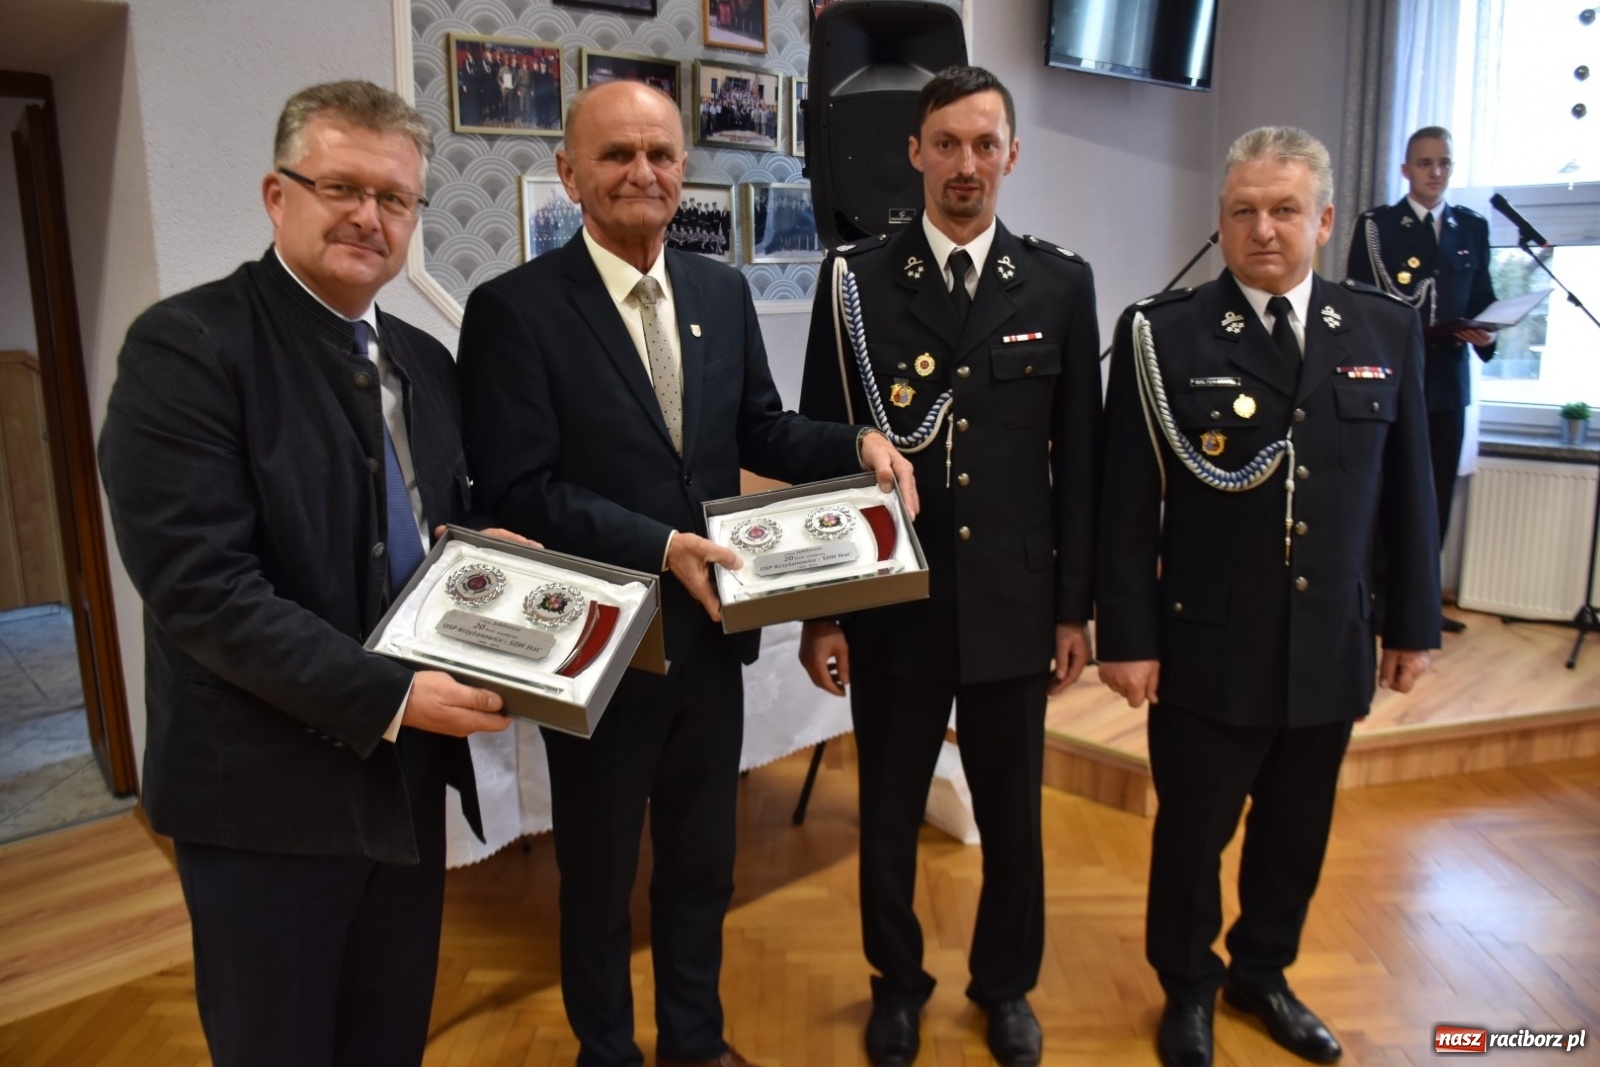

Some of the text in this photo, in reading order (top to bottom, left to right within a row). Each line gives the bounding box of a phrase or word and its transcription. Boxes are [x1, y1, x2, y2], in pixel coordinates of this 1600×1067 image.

[783, 555, 794, 563] 20
[442, 622, 458, 631] OSP
[472, 621, 486, 631] 20
